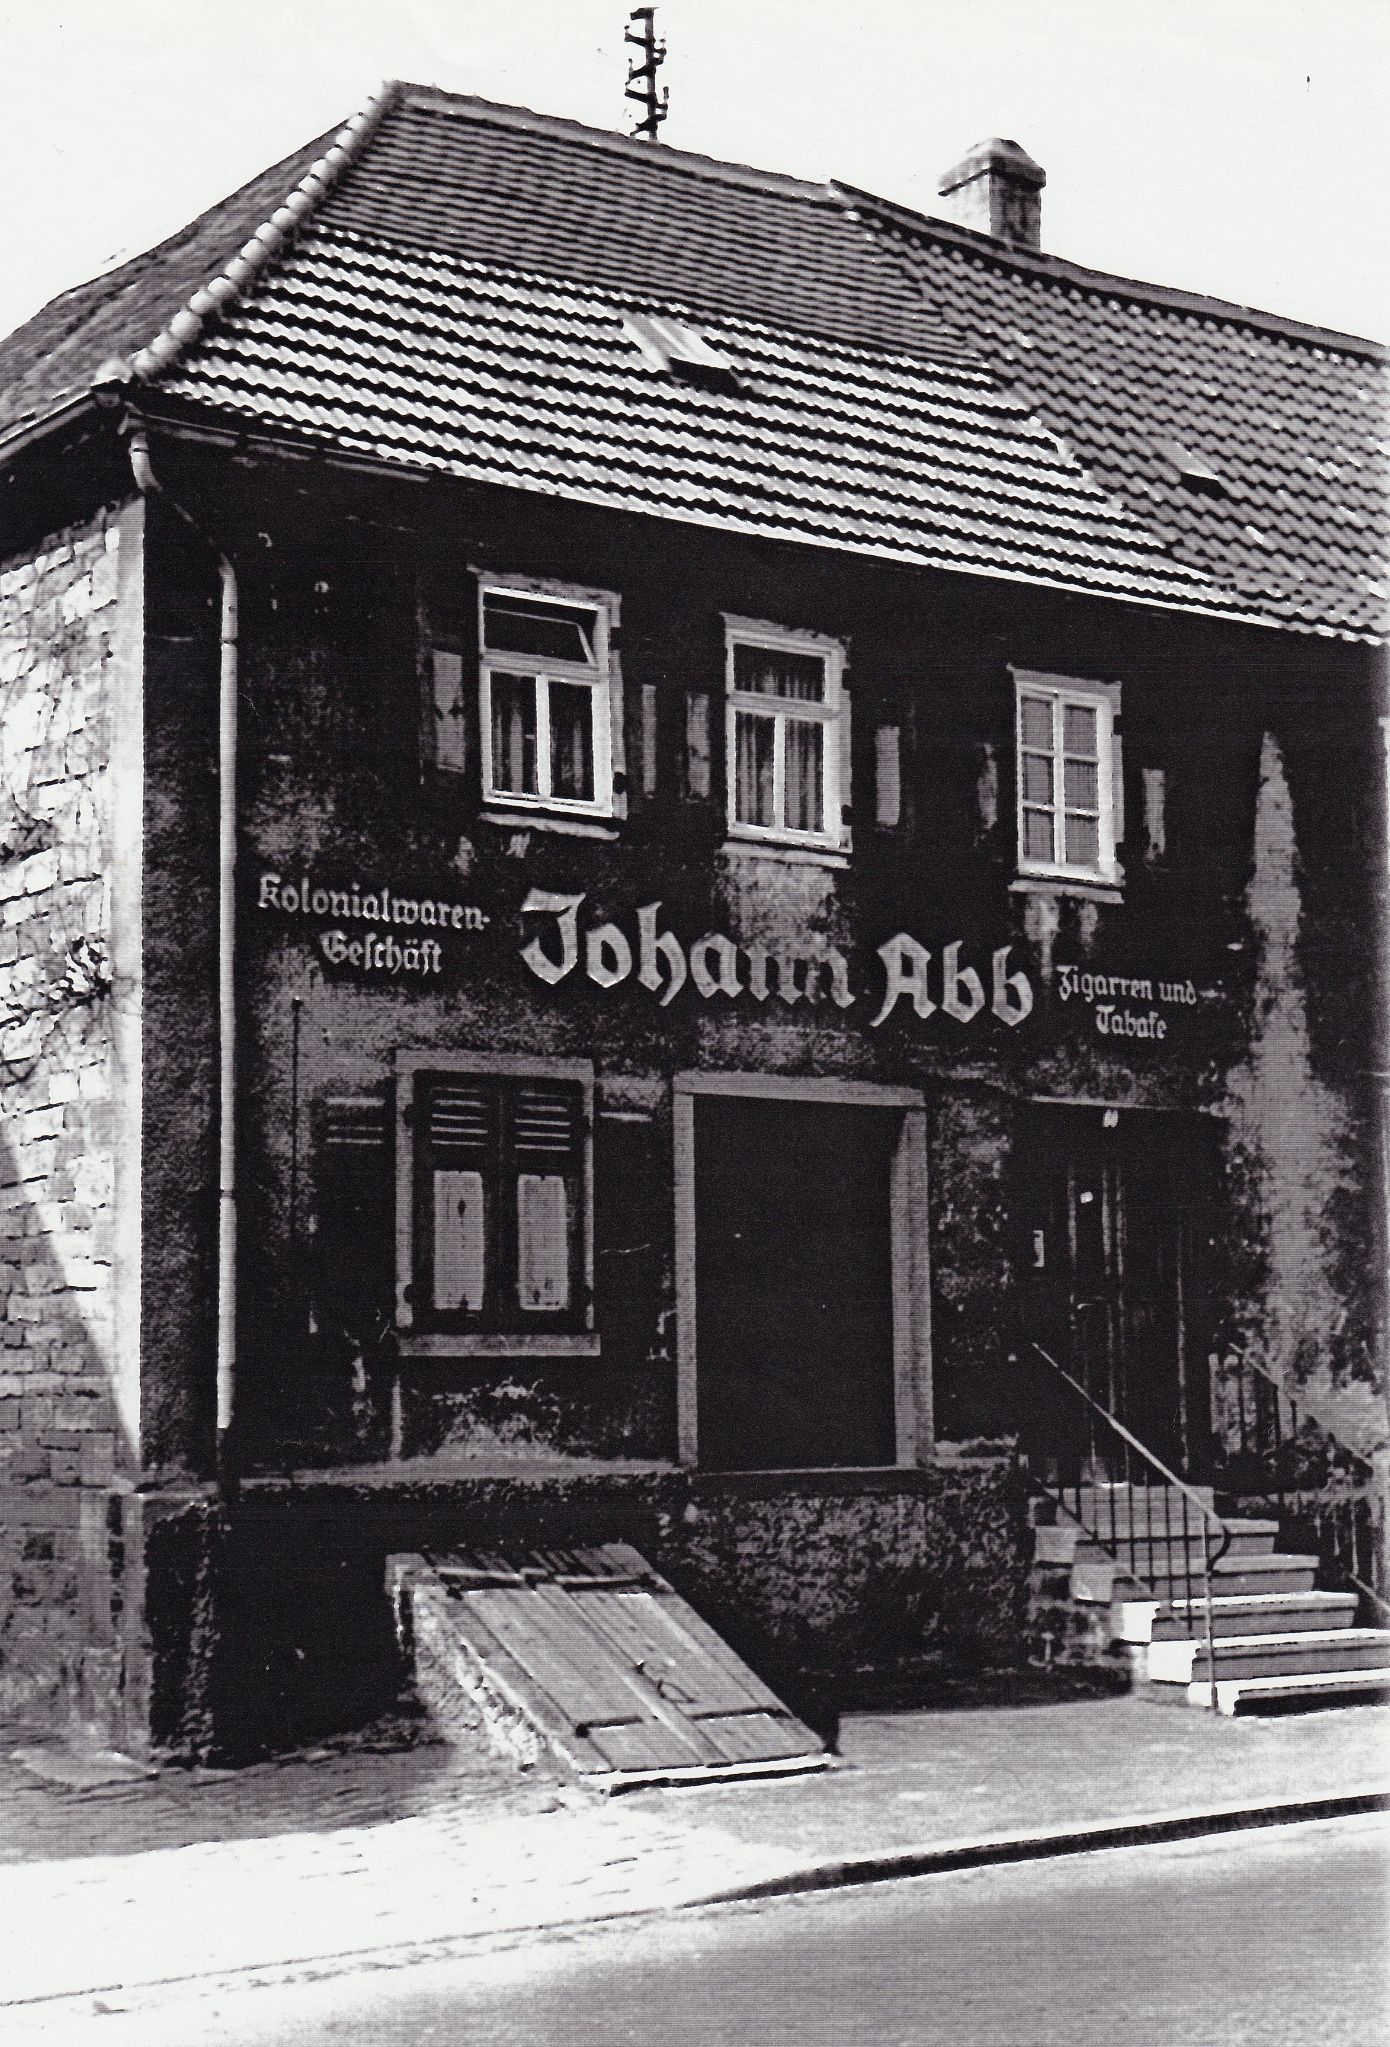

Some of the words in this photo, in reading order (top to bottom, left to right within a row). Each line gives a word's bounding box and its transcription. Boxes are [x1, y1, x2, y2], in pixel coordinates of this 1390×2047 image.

[520, 887, 856, 1008] Johann
[870, 931, 1034, 1027] Abb
[1055, 964, 1153, 1003] Zigarren
[1158, 979, 1197, 1006] und
[1095, 1004, 1168, 1039] Tabake
